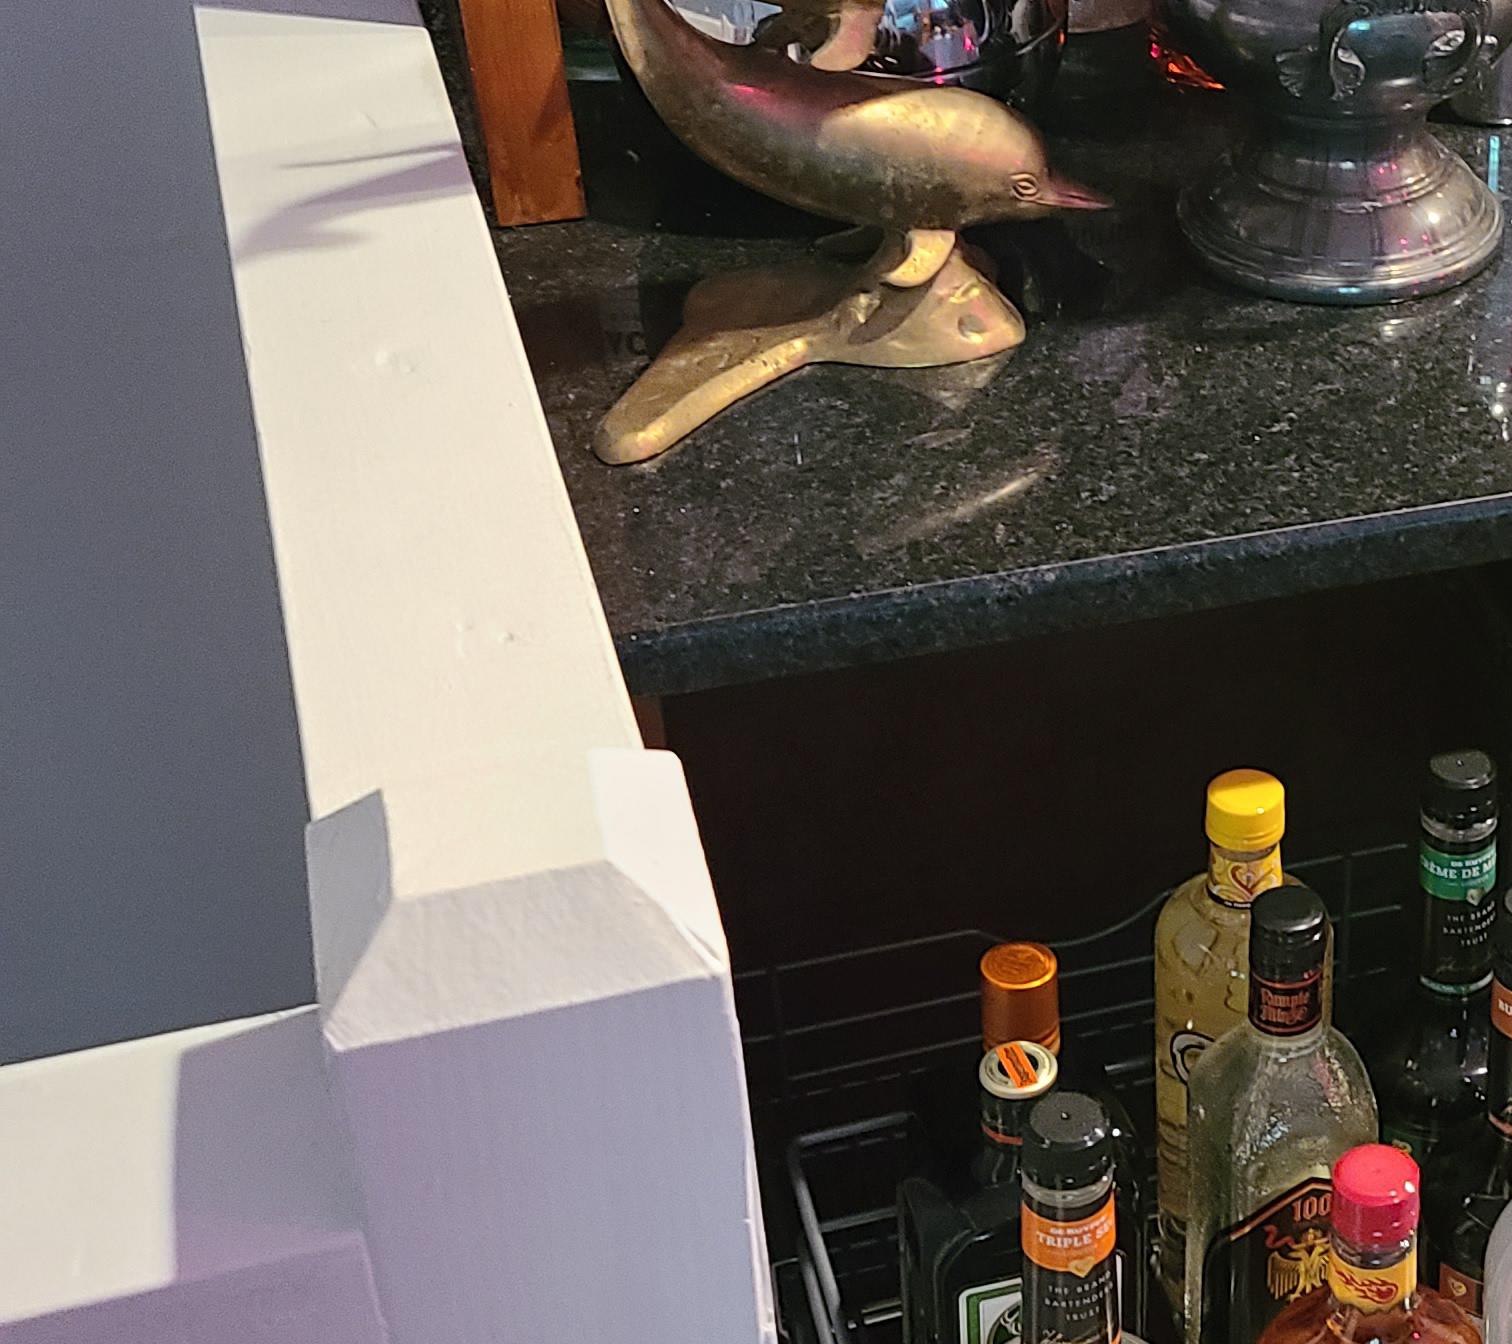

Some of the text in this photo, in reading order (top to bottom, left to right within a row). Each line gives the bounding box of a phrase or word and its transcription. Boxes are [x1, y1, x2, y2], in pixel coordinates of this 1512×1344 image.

[1461, 866, 1481, 879] DE
[1292, 1192, 1332, 1223] 100
[1036, 1230, 1092, 1250] TRIPLE
[1049, 1284, 1069, 1296] THE
